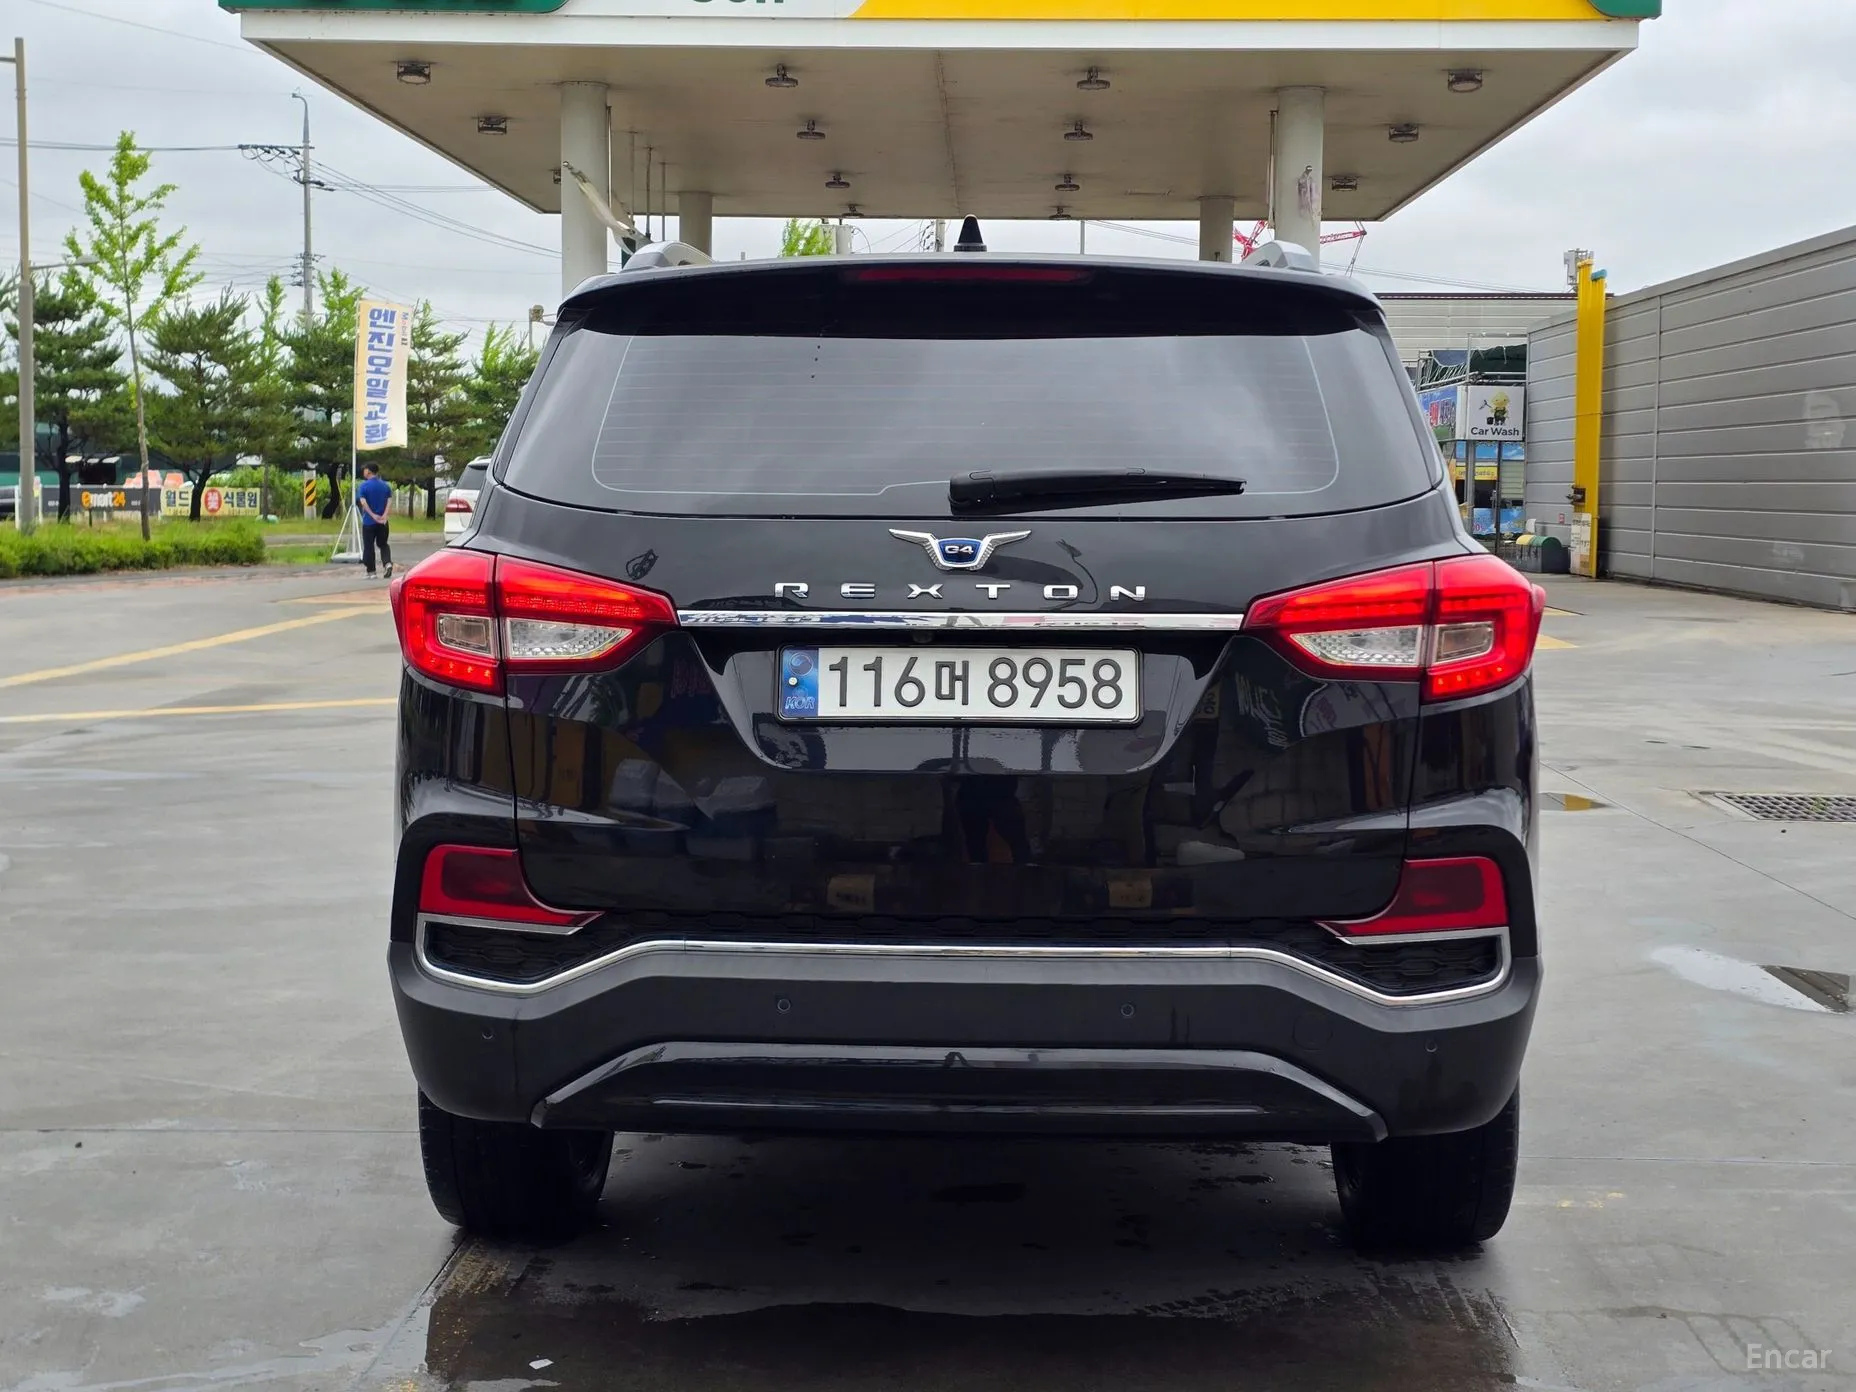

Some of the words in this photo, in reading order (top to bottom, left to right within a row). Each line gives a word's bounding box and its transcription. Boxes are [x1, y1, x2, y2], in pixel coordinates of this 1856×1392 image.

[364, 308, 397, 444] 엔진오일교환
[1470, 427, 1489, 436] Car
[1490, 427, 1520, 436] Wash
[81, 490, 126, 508] emart24
[944, 545, 974, 555] G4
[774, 582, 1147, 601] REXTON
[828, 656, 970, 708] 116머
[987, 657, 1123, 710] 8958
[785, 696, 816, 710] KOR
